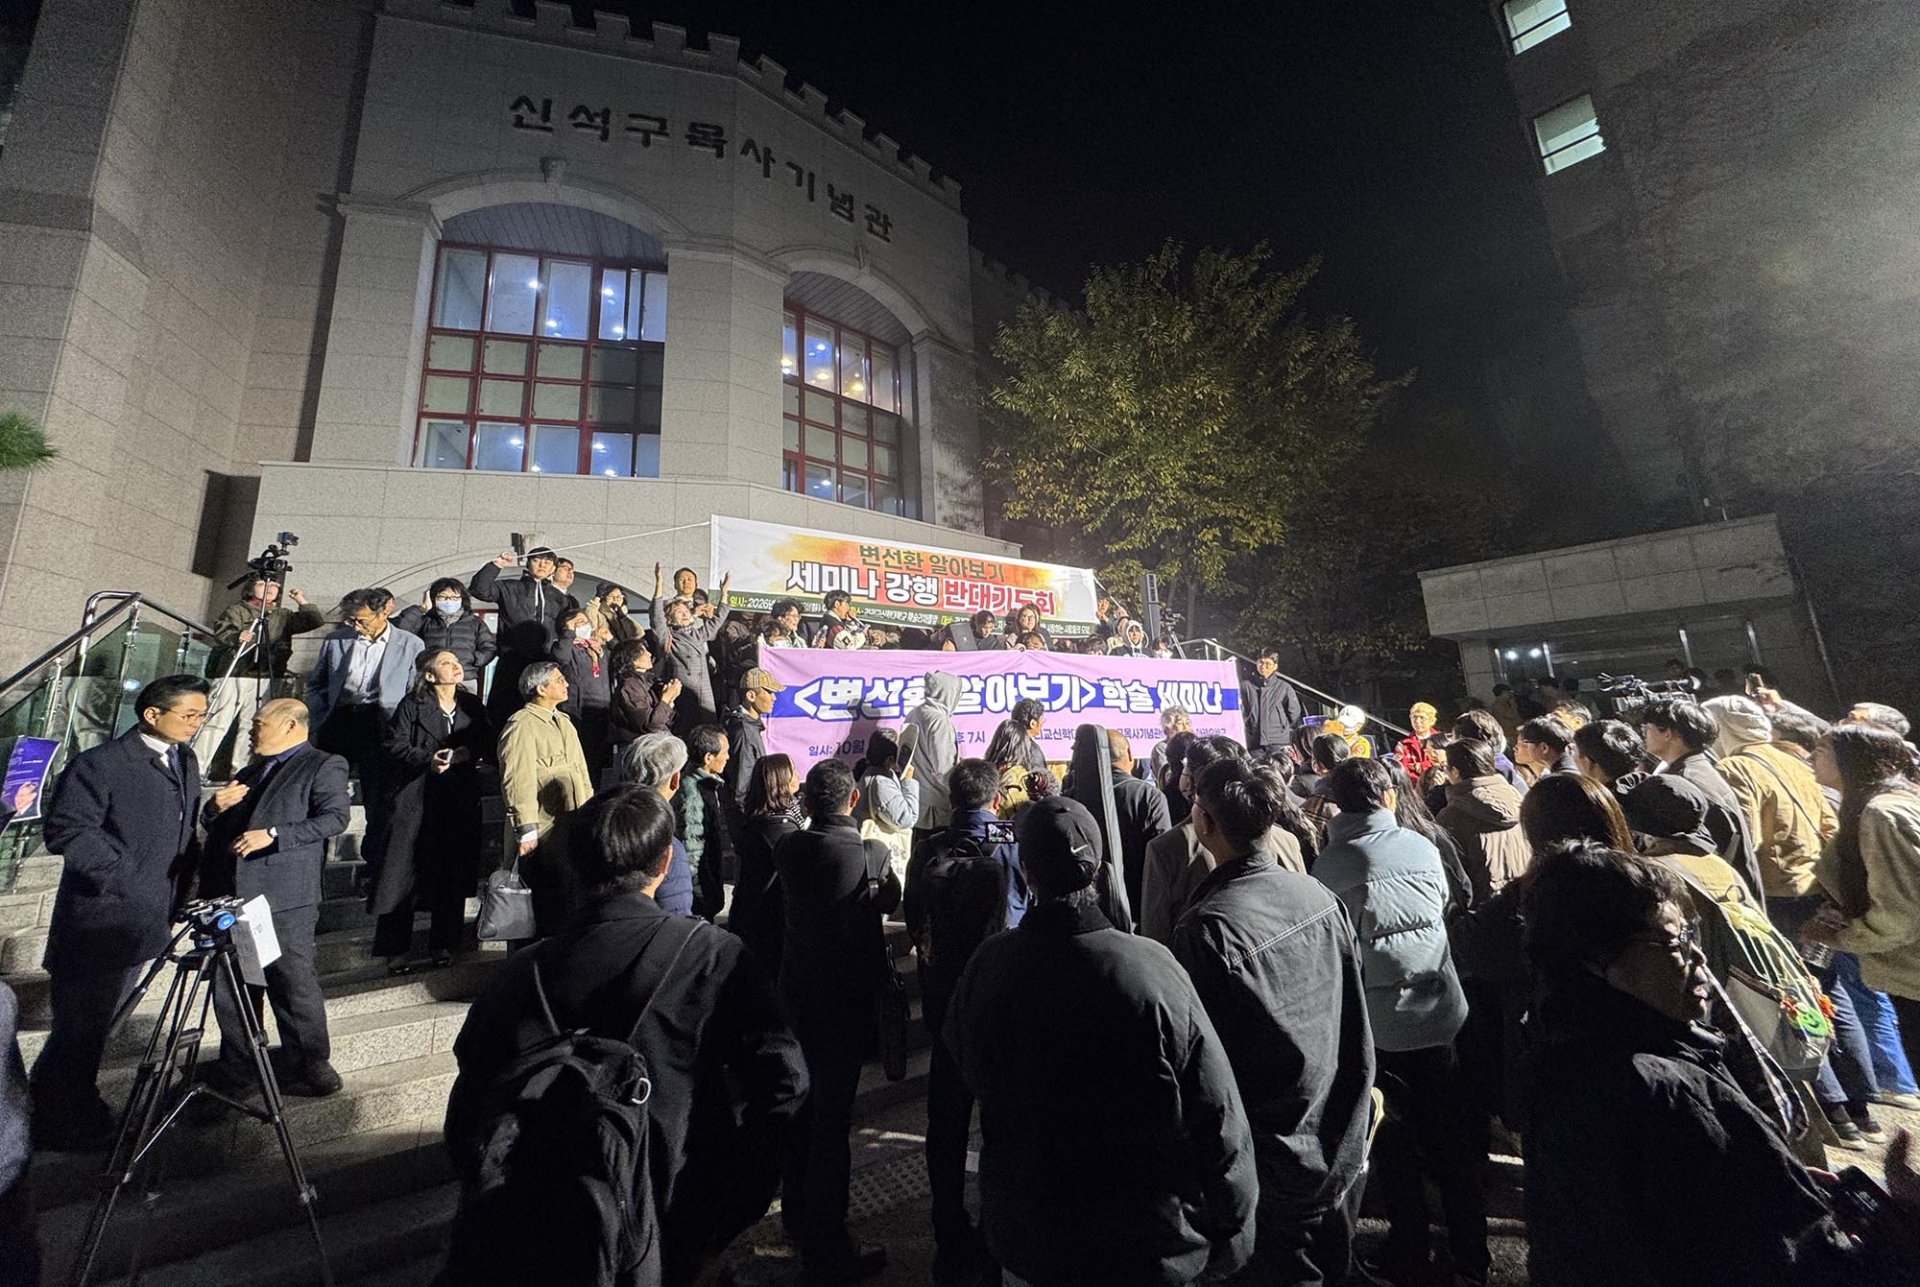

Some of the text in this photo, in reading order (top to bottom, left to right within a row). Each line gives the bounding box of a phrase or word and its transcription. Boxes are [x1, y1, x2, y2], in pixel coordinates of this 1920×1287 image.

[859, 544, 1005, 582] 변선환 알아보기
[786, 560, 881, 600] 세미나
[885, 570, 939, 607] 강행
[953, 672, 1097, 715] 알아보기>
[1097, 677, 1155, 713] 학술
[809, 745, 833, 756] 일시:
[836, 739, 865, 754] 10월
[967, 731, 986, 744] 7시
